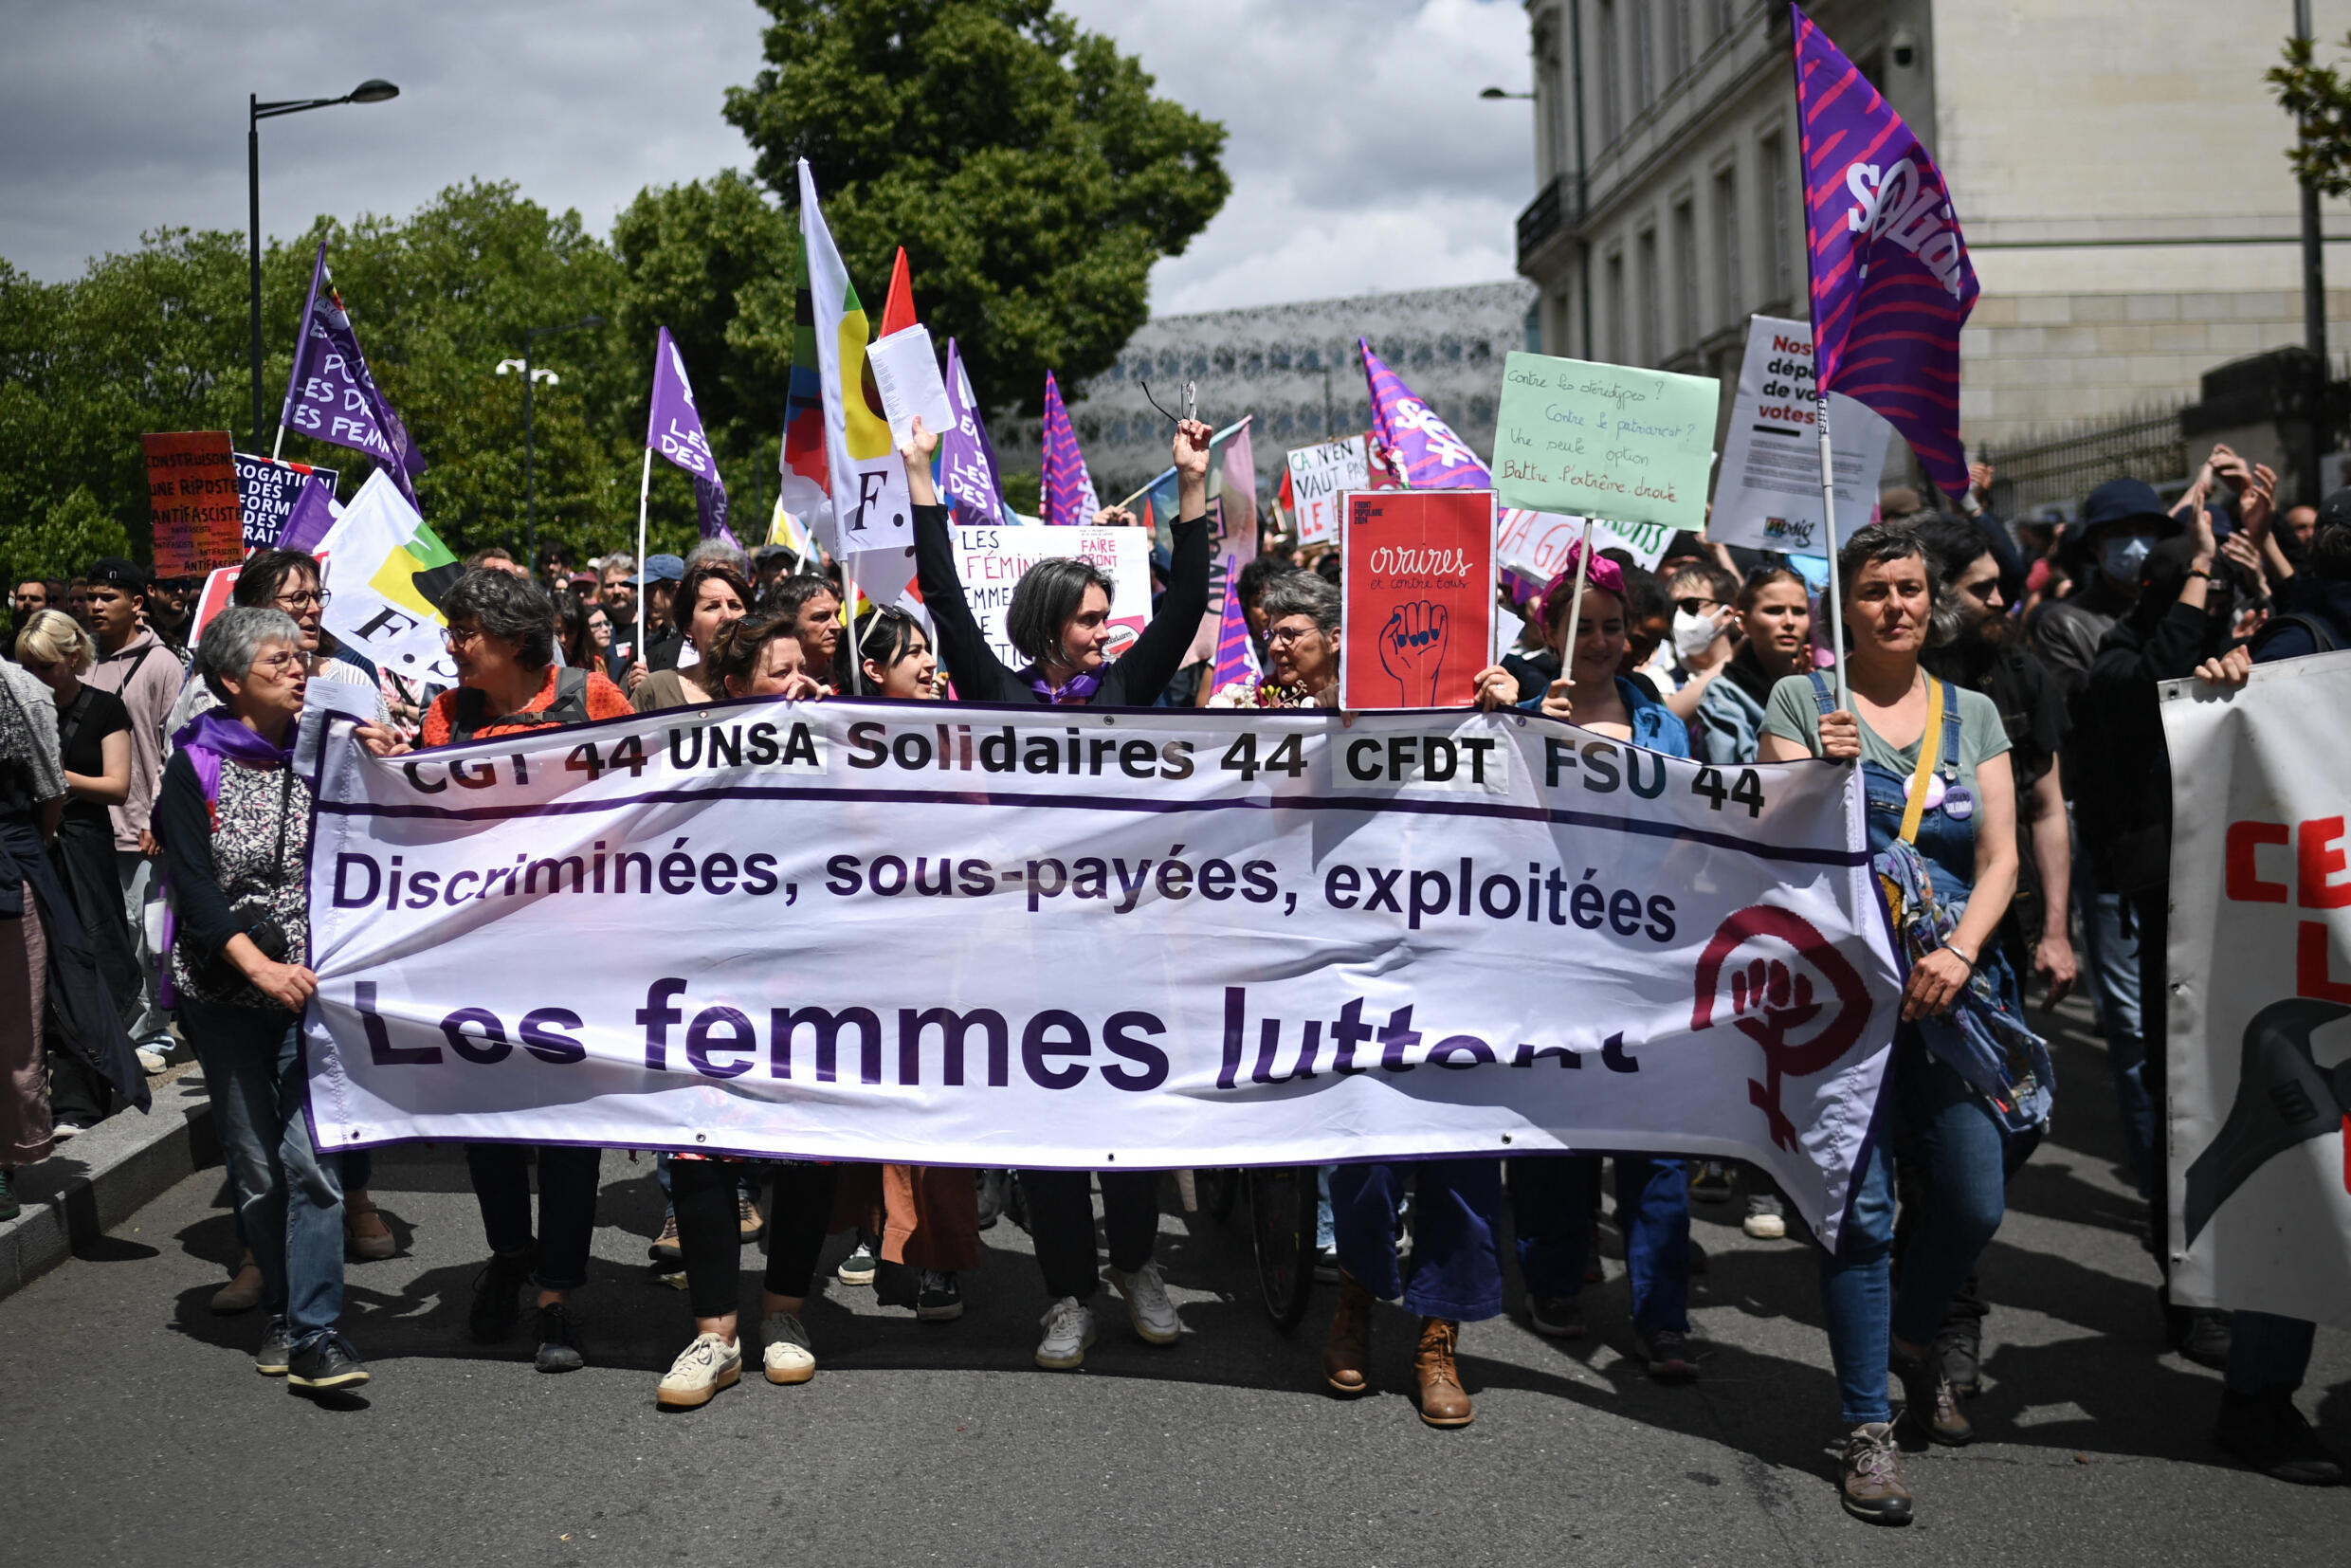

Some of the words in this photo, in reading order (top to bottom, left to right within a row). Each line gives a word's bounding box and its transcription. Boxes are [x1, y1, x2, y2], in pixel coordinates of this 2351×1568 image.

[1773, 335, 1813, 356] Nos
[1508, 370, 1547, 388] Contre
[1557, 374, 1575, 391] les
[1763, 380, 1790, 398] de
[1795, 387, 1829, 402] vo
[1545, 404, 1585, 427] Contre
[1596, 411, 1608, 428] le
[1759, 403, 1816, 426] votes
[662, 434, 706, 472] DES
[1510, 428, 1533, 447] Une
[1546, 438, 1586, 455] seule
[1606, 447, 1649, 469] option
[954, 453, 991, 491] LES
[1296, 466, 1339, 500] VAUT
[1347, 458, 1369, 481] PAS
[1502, 459, 1549, 483] Battre
[248, 480, 283, 500] DES
[950, 473, 988, 510] DES
[243, 510, 278, 529] DES
[1300, 501, 1323, 538] LE
[962, 530, 1000, 550] LES
[1370, 542, 1474, 576] ovaires
[1370, 577, 1382, 590] et
[1390, 576, 1432, 590] contre
[1436, 576, 1470, 590] tous
[565, 735, 647, 781] 44
[668, 721, 819, 771] UNSA
[846, 721, 1194, 780] Solidaires
[1220, 733, 1308, 782] 44
[1346, 736, 1495, 784] CFDT
[1545, 736, 1667, 800] FSU
[1691, 766, 1765, 819] 44
[332, 837, 798, 910] Discriminées,
[825, 844, 1298, 917] sous-payées,
[1324, 857, 1676, 942] exploitées
[355, 980, 587, 1066] Les
[636, 976, 1169, 1092] femmes
